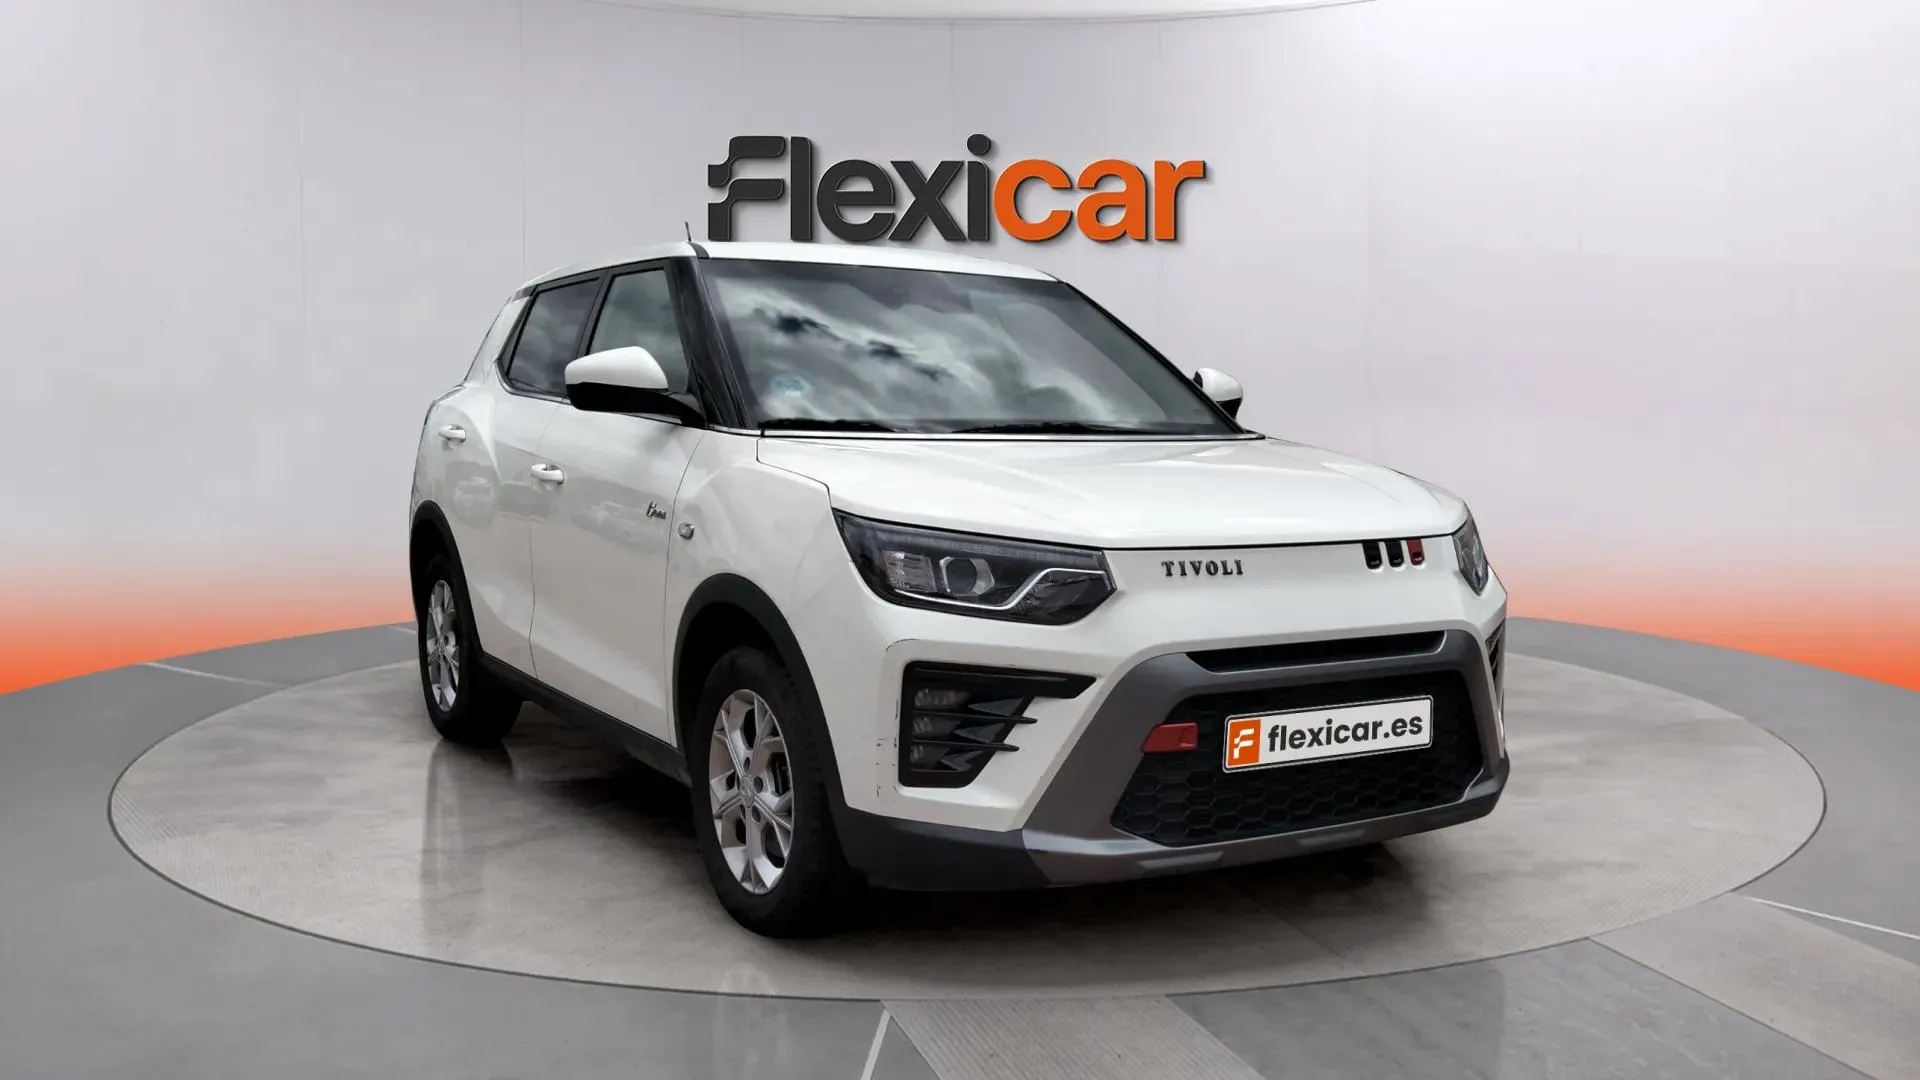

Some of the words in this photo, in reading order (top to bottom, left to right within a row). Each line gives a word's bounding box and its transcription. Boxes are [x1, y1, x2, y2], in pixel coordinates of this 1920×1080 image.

[708, 134, 1205, 241] Flexicar
[1161, 558, 1244, 577] TIVOLI
[1268, 716, 1423, 752] flexicar.es
